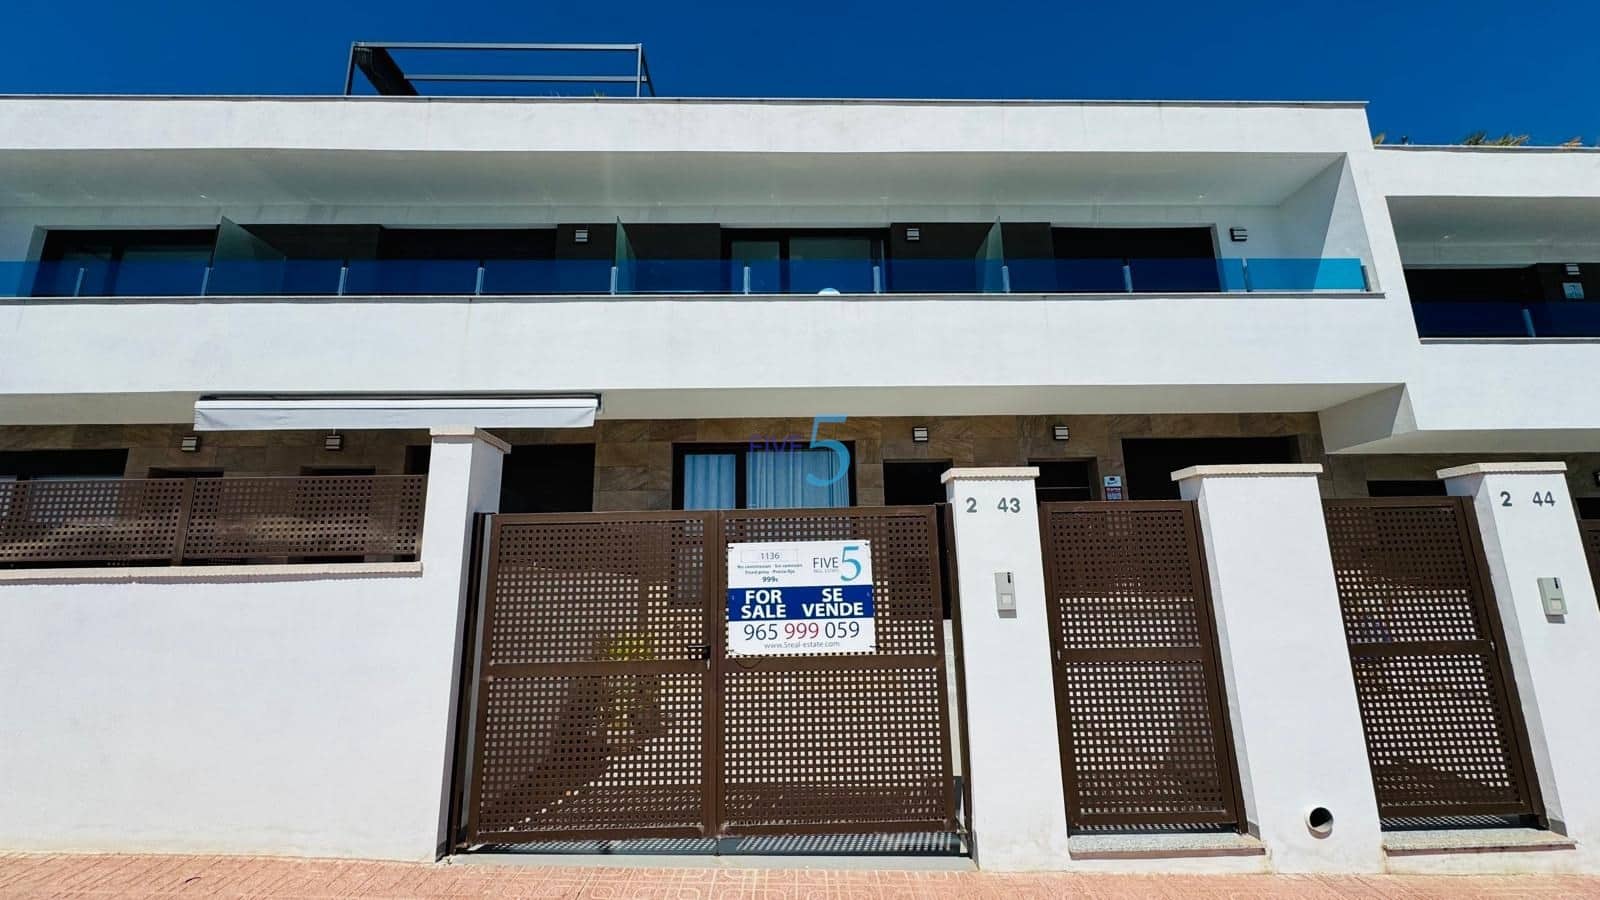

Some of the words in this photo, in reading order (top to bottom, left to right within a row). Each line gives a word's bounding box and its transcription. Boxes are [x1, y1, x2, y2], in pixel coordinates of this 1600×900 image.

[966, 497, 977, 513] 2
[997, 497, 1021, 513] 43
[1500, 491, 1513, 507] 2
[1532, 491, 1556, 507] 44
[760, 552, 780, 561] 1136
[813, 557, 839, 569] FIVE
[840, 546, 862, 581] 5
[745, 589, 783, 604] FOR
[822, 588, 843, 602] SE
[741, 604, 787, 619] SALE
[802, 602, 864, 617] VENDE
[744, 623, 778, 641] 965
[784, 622, 820, 640] 999
[825, 621, 860, 639] 059
